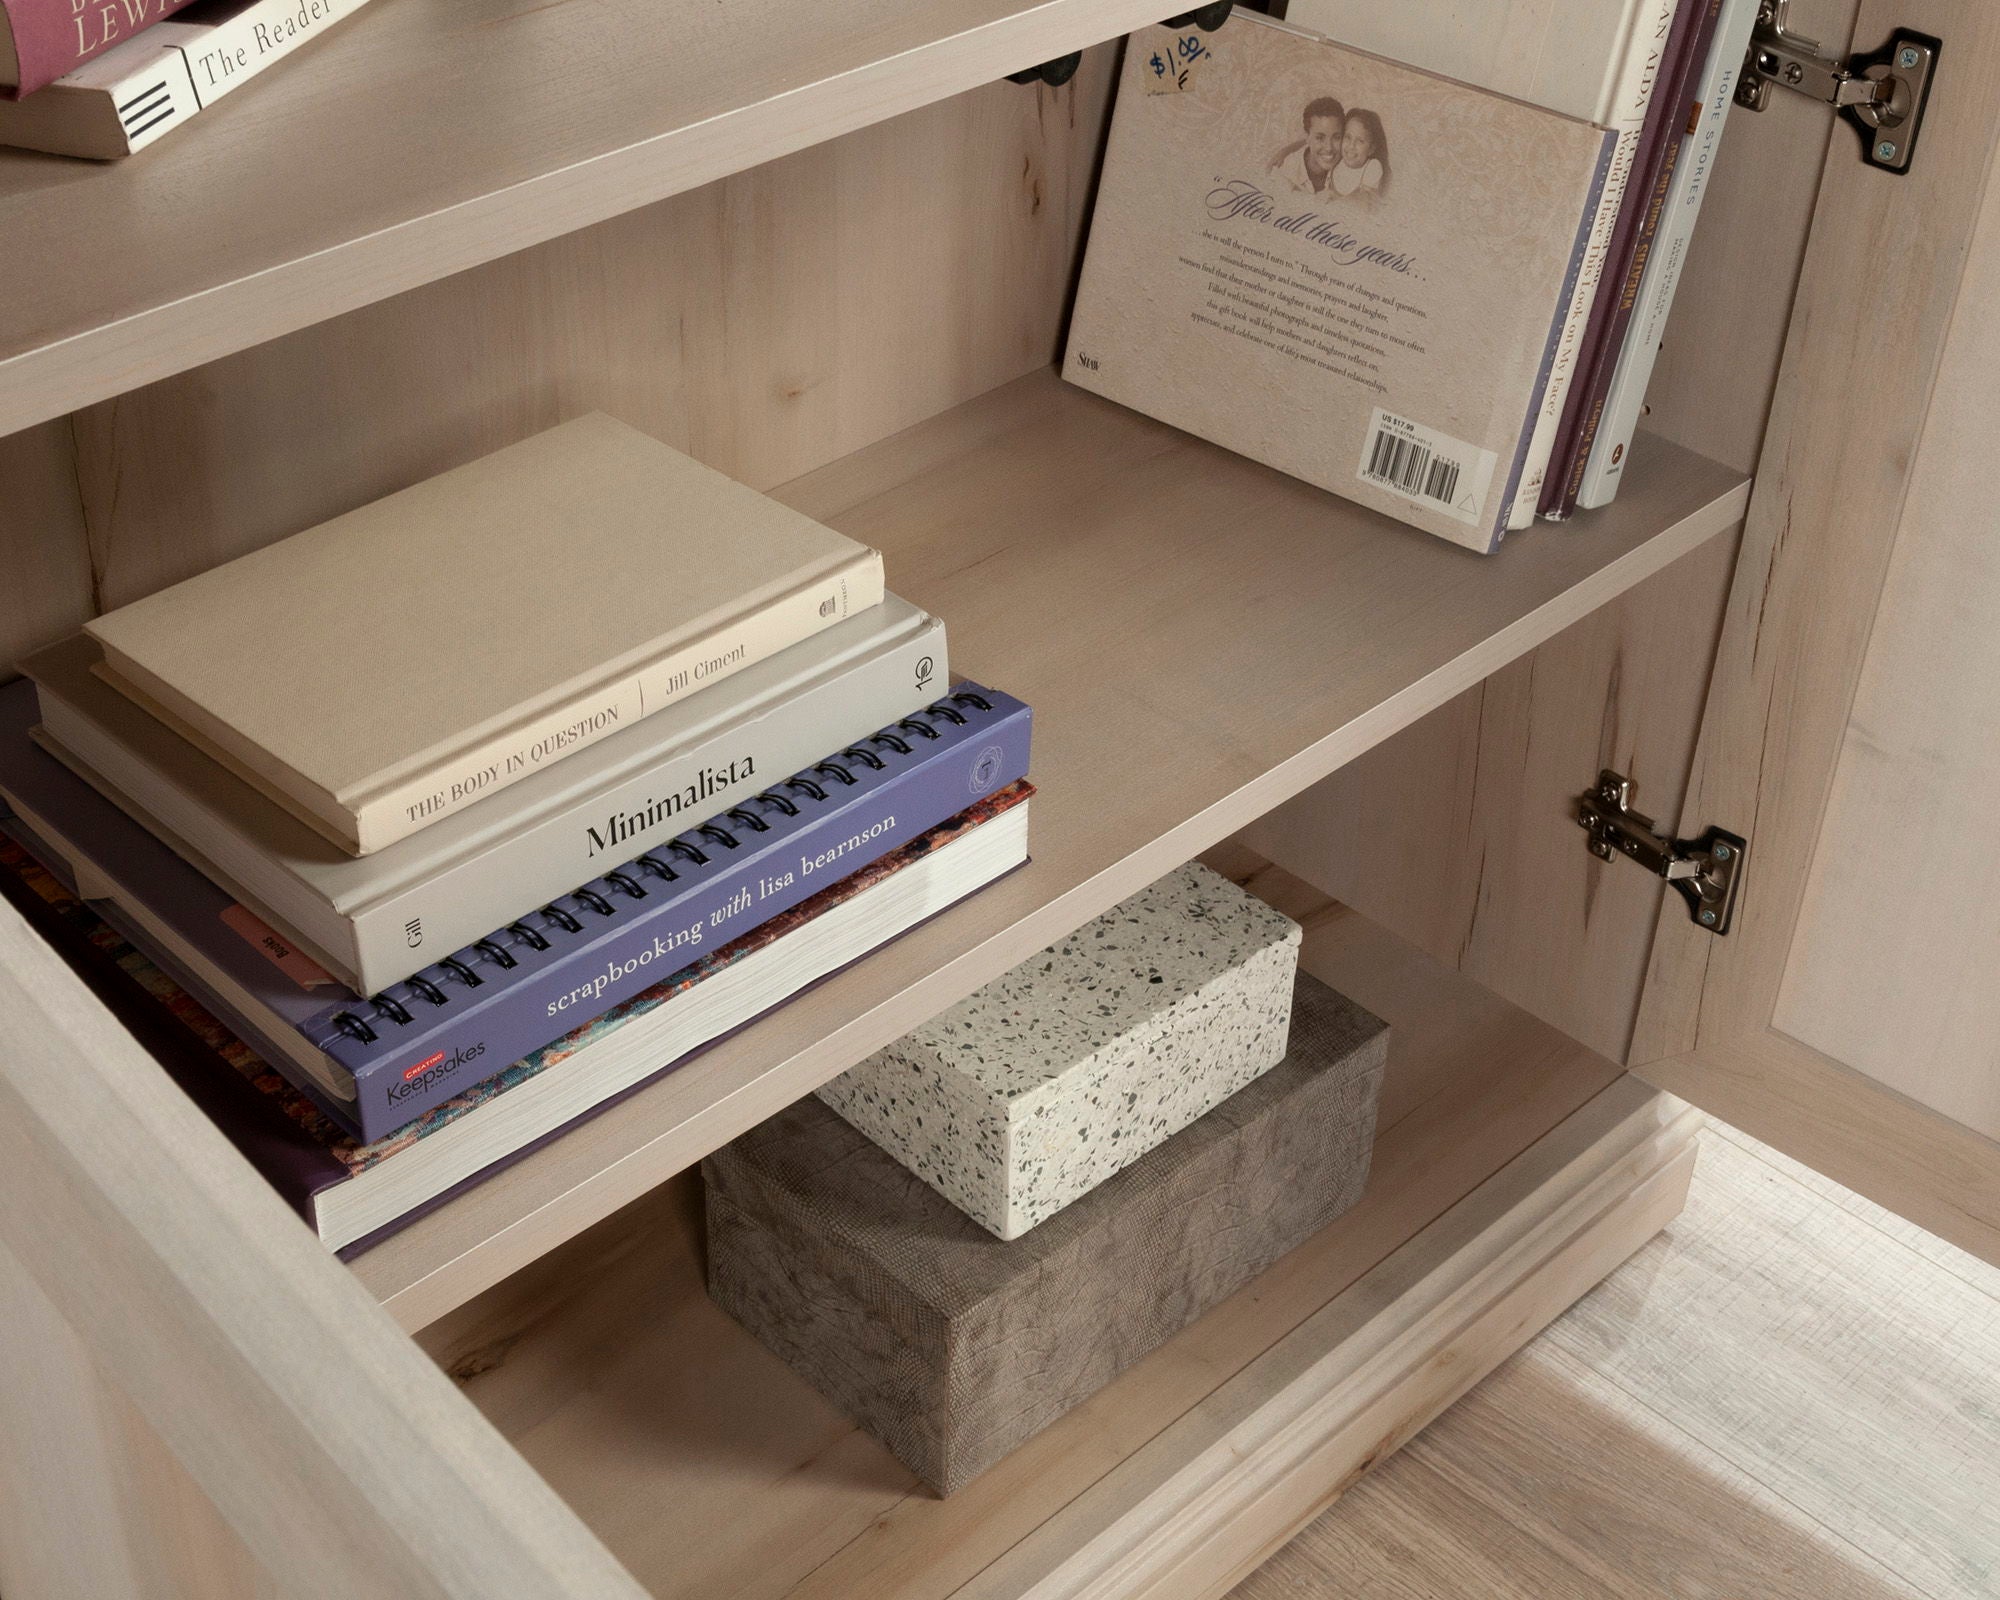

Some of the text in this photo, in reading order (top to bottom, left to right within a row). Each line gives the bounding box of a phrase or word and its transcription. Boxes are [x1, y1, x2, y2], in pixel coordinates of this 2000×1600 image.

[74, 0, 183, 57] LEW
[199, 48, 248, 86] The
[1635, 49, 1658, 109] ALDA
[1612, 131, 1631, 182] Would
[1687, 70, 1731, 205] HOME STORIES
[1274, 212, 1318, 235] all
[1305, 221, 1357, 252] these
[1596, 199, 1612, 237] Have
[1586, 241, 1601, 276] This
[1277, 272, 1291, 284] and
[1348, 299, 1361, 310] and
[1381, 294, 1395, 306] and
[1573, 280, 1590, 320] Look
[1581, 446, 1588, 455] &
[1656, 173, 1669, 193] the
[1664, 142, 1679, 169] year
[1567, 324, 1575, 342] on
[1556, 349, 1571, 371] My
[1547, 377, 1563, 415] Face?
[1381, 413, 1415, 431] US $17.99
[406, 644, 746, 824] THE BODY IN QUESTION Jill Ciment
[585, 755, 756, 858] Minimalista
[405, 917, 424, 949] Gill
[547, 813, 896, 1017] scrapbooking with lisa bearnson
[262, 936, 290, 960] Books
[387, 1041, 486, 1106] Keepsakes
[405, 1053, 444, 1080] CREATING
